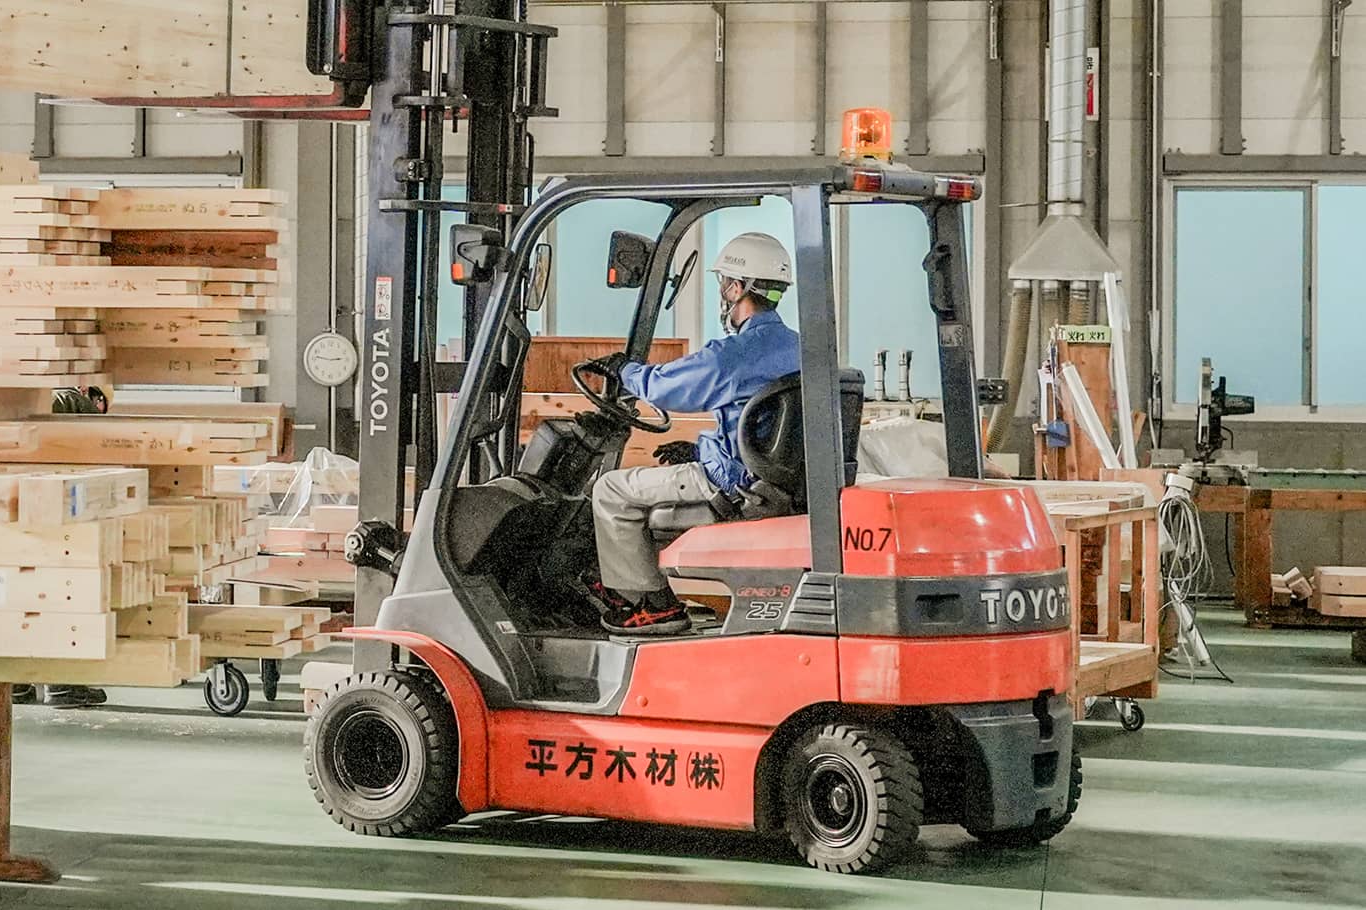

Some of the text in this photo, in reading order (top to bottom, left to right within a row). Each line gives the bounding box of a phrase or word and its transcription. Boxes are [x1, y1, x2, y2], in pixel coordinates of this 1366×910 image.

[369, 327, 390, 437] TOYOTA
[745, 601, 784, 620] 25
[980, 584, 1069, 623] TOYOT
[525, 739, 725, 790] 平方木材(株)
